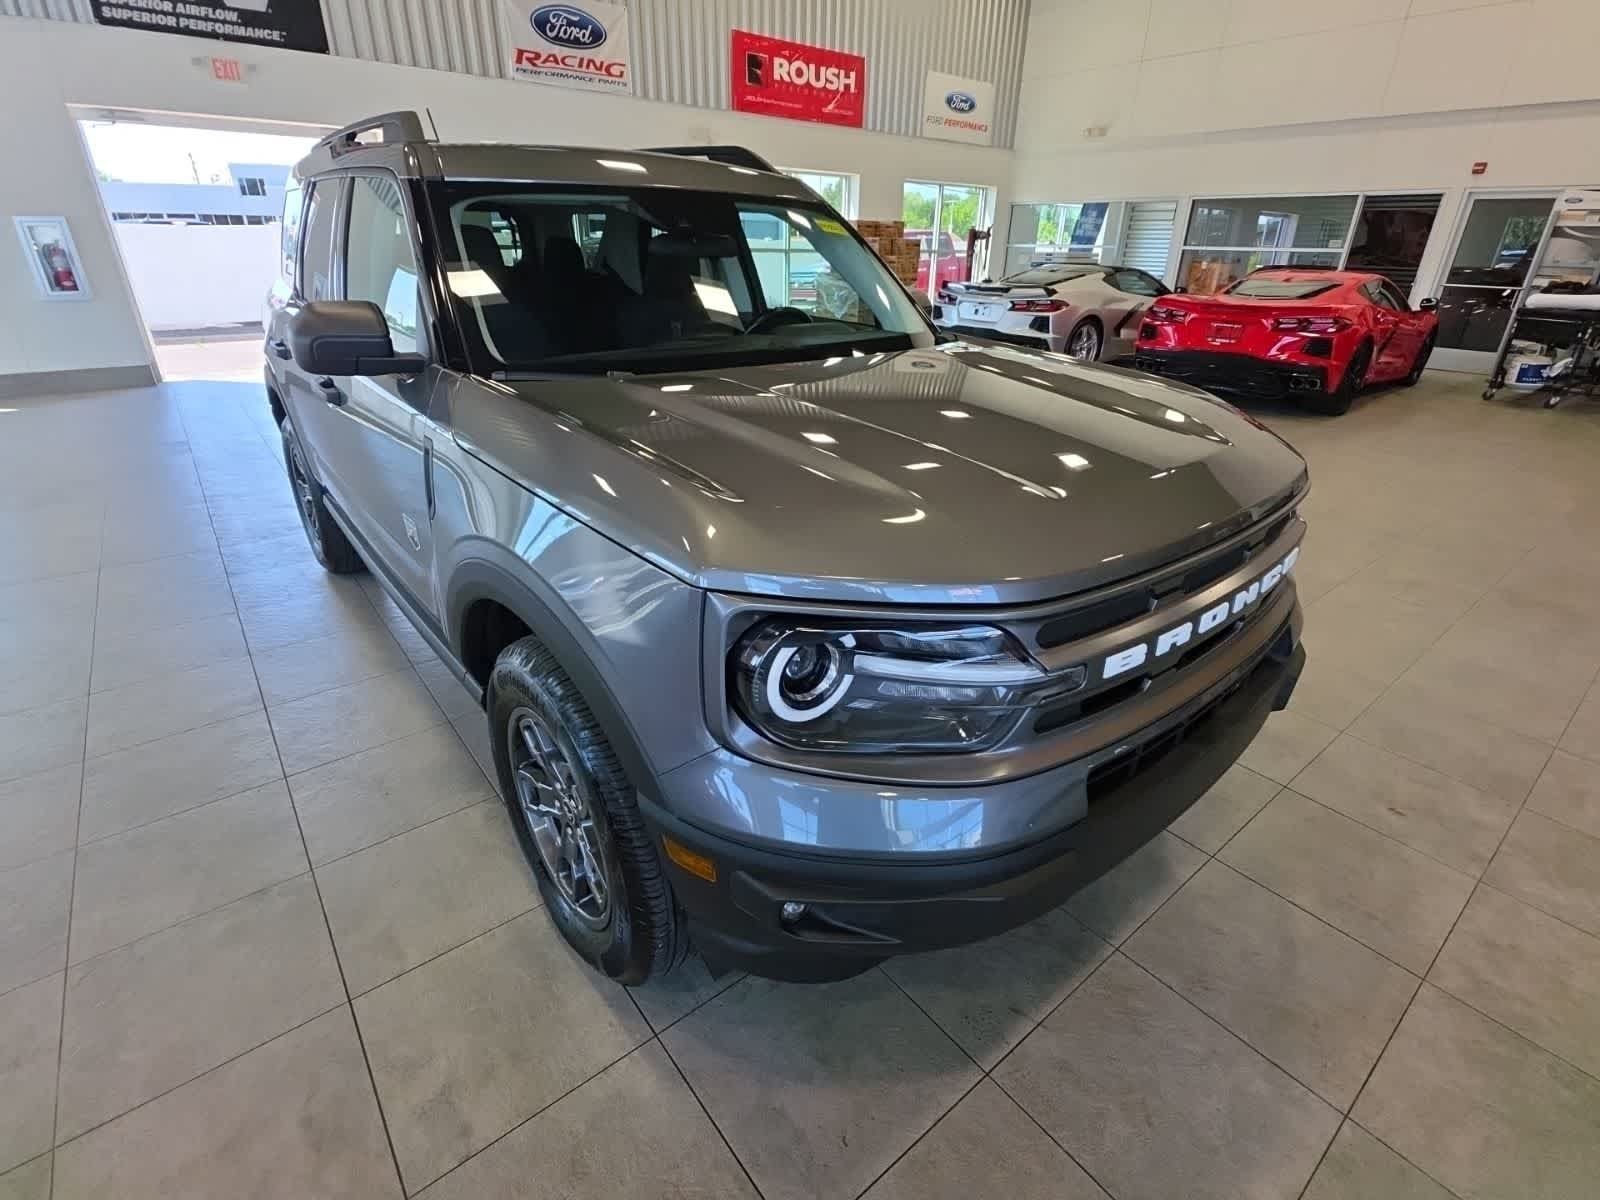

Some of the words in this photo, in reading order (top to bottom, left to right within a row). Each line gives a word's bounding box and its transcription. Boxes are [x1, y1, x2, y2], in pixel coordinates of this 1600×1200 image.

[101, 0, 173, 12] ERIOR
[176, 2, 242, 22] AIRFLOW.
[101, 6, 177, 27] SUPERIOR
[546, 9, 593, 43] Ford
[514, 47, 627, 78] RACING
[773, 56, 856, 93] ROUSH
[516, 67, 595, 84] PERFORMANCE
[598, 79, 628, 88] PARTS
